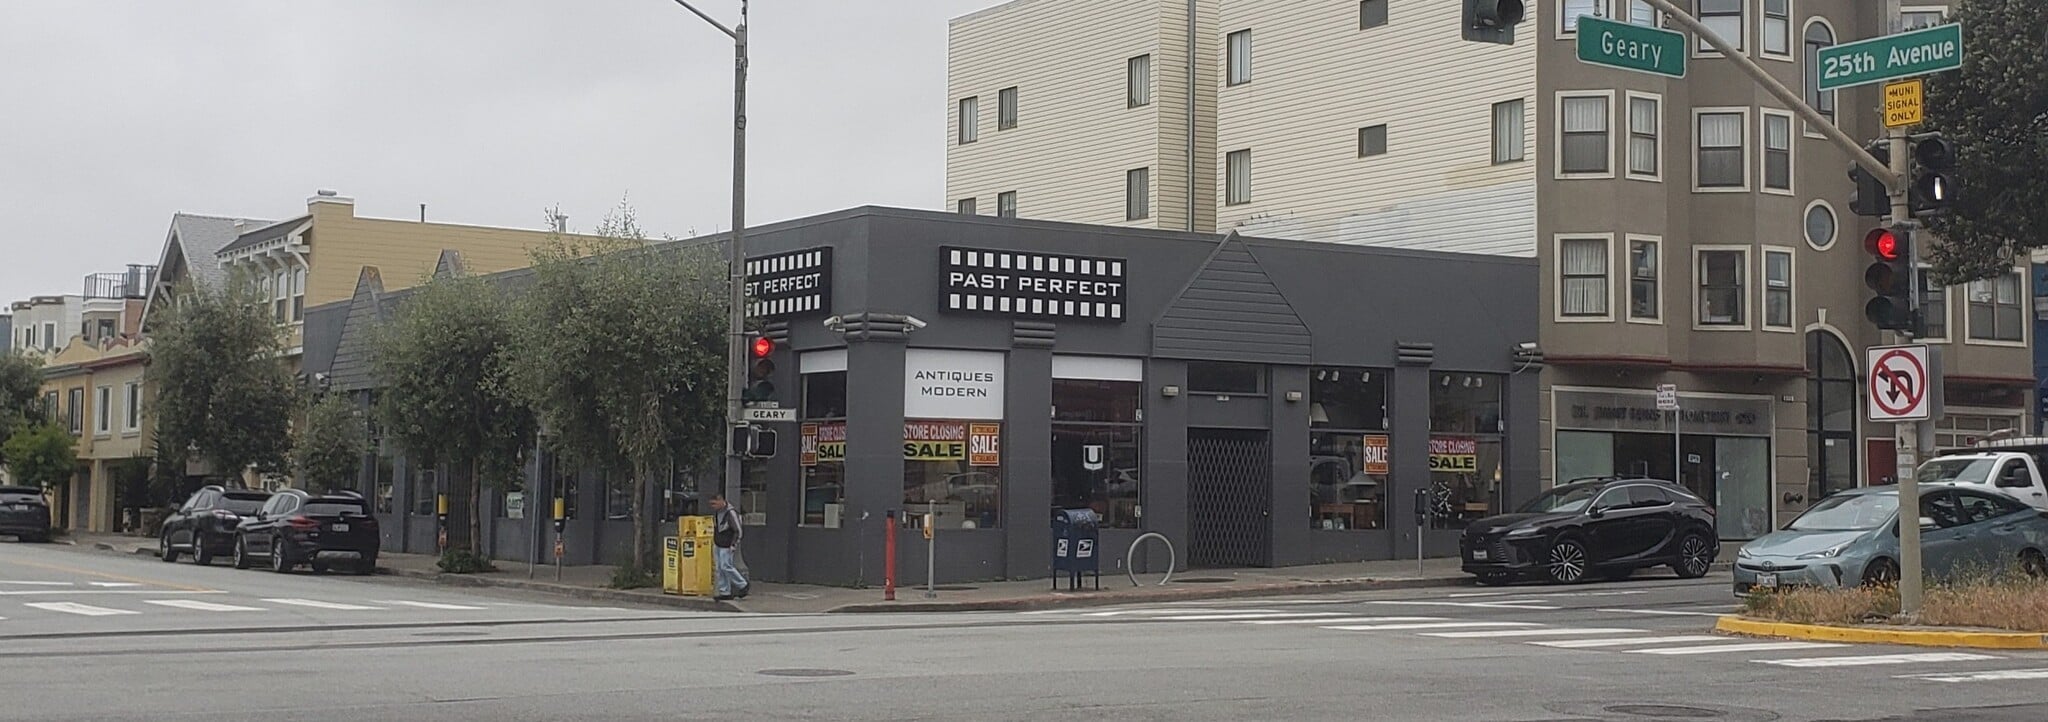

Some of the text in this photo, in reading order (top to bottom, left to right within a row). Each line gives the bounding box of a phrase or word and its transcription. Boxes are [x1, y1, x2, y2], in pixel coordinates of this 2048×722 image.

[1602, 31, 1662, 68] Geary
[1824, 40, 1954, 79] 25th Avenue
[1891, 85, 1914, 97] MUNI
[1887, 97, 1919, 111] SIGNAL
[1890, 109, 1916, 121] ONLY
[744, 273, 821, 297] ST PERFECT
[950, 272, 1121, 297] PAST PERFECT
[914, 370, 993, 383] ANTIQUES
[921, 386, 987, 398] MODERN
[753, 410, 786, 419] GEARY
[904, 424, 964, 440] STORE CLOSING
[904, 443, 962, 457] SALE
[971, 435, 998, 454] SALE
[1448, 440, 1475, 454] CLOSING
[1365, 446, 1388, 463] SALE
[1429, 457, 1474, 469] SALE
